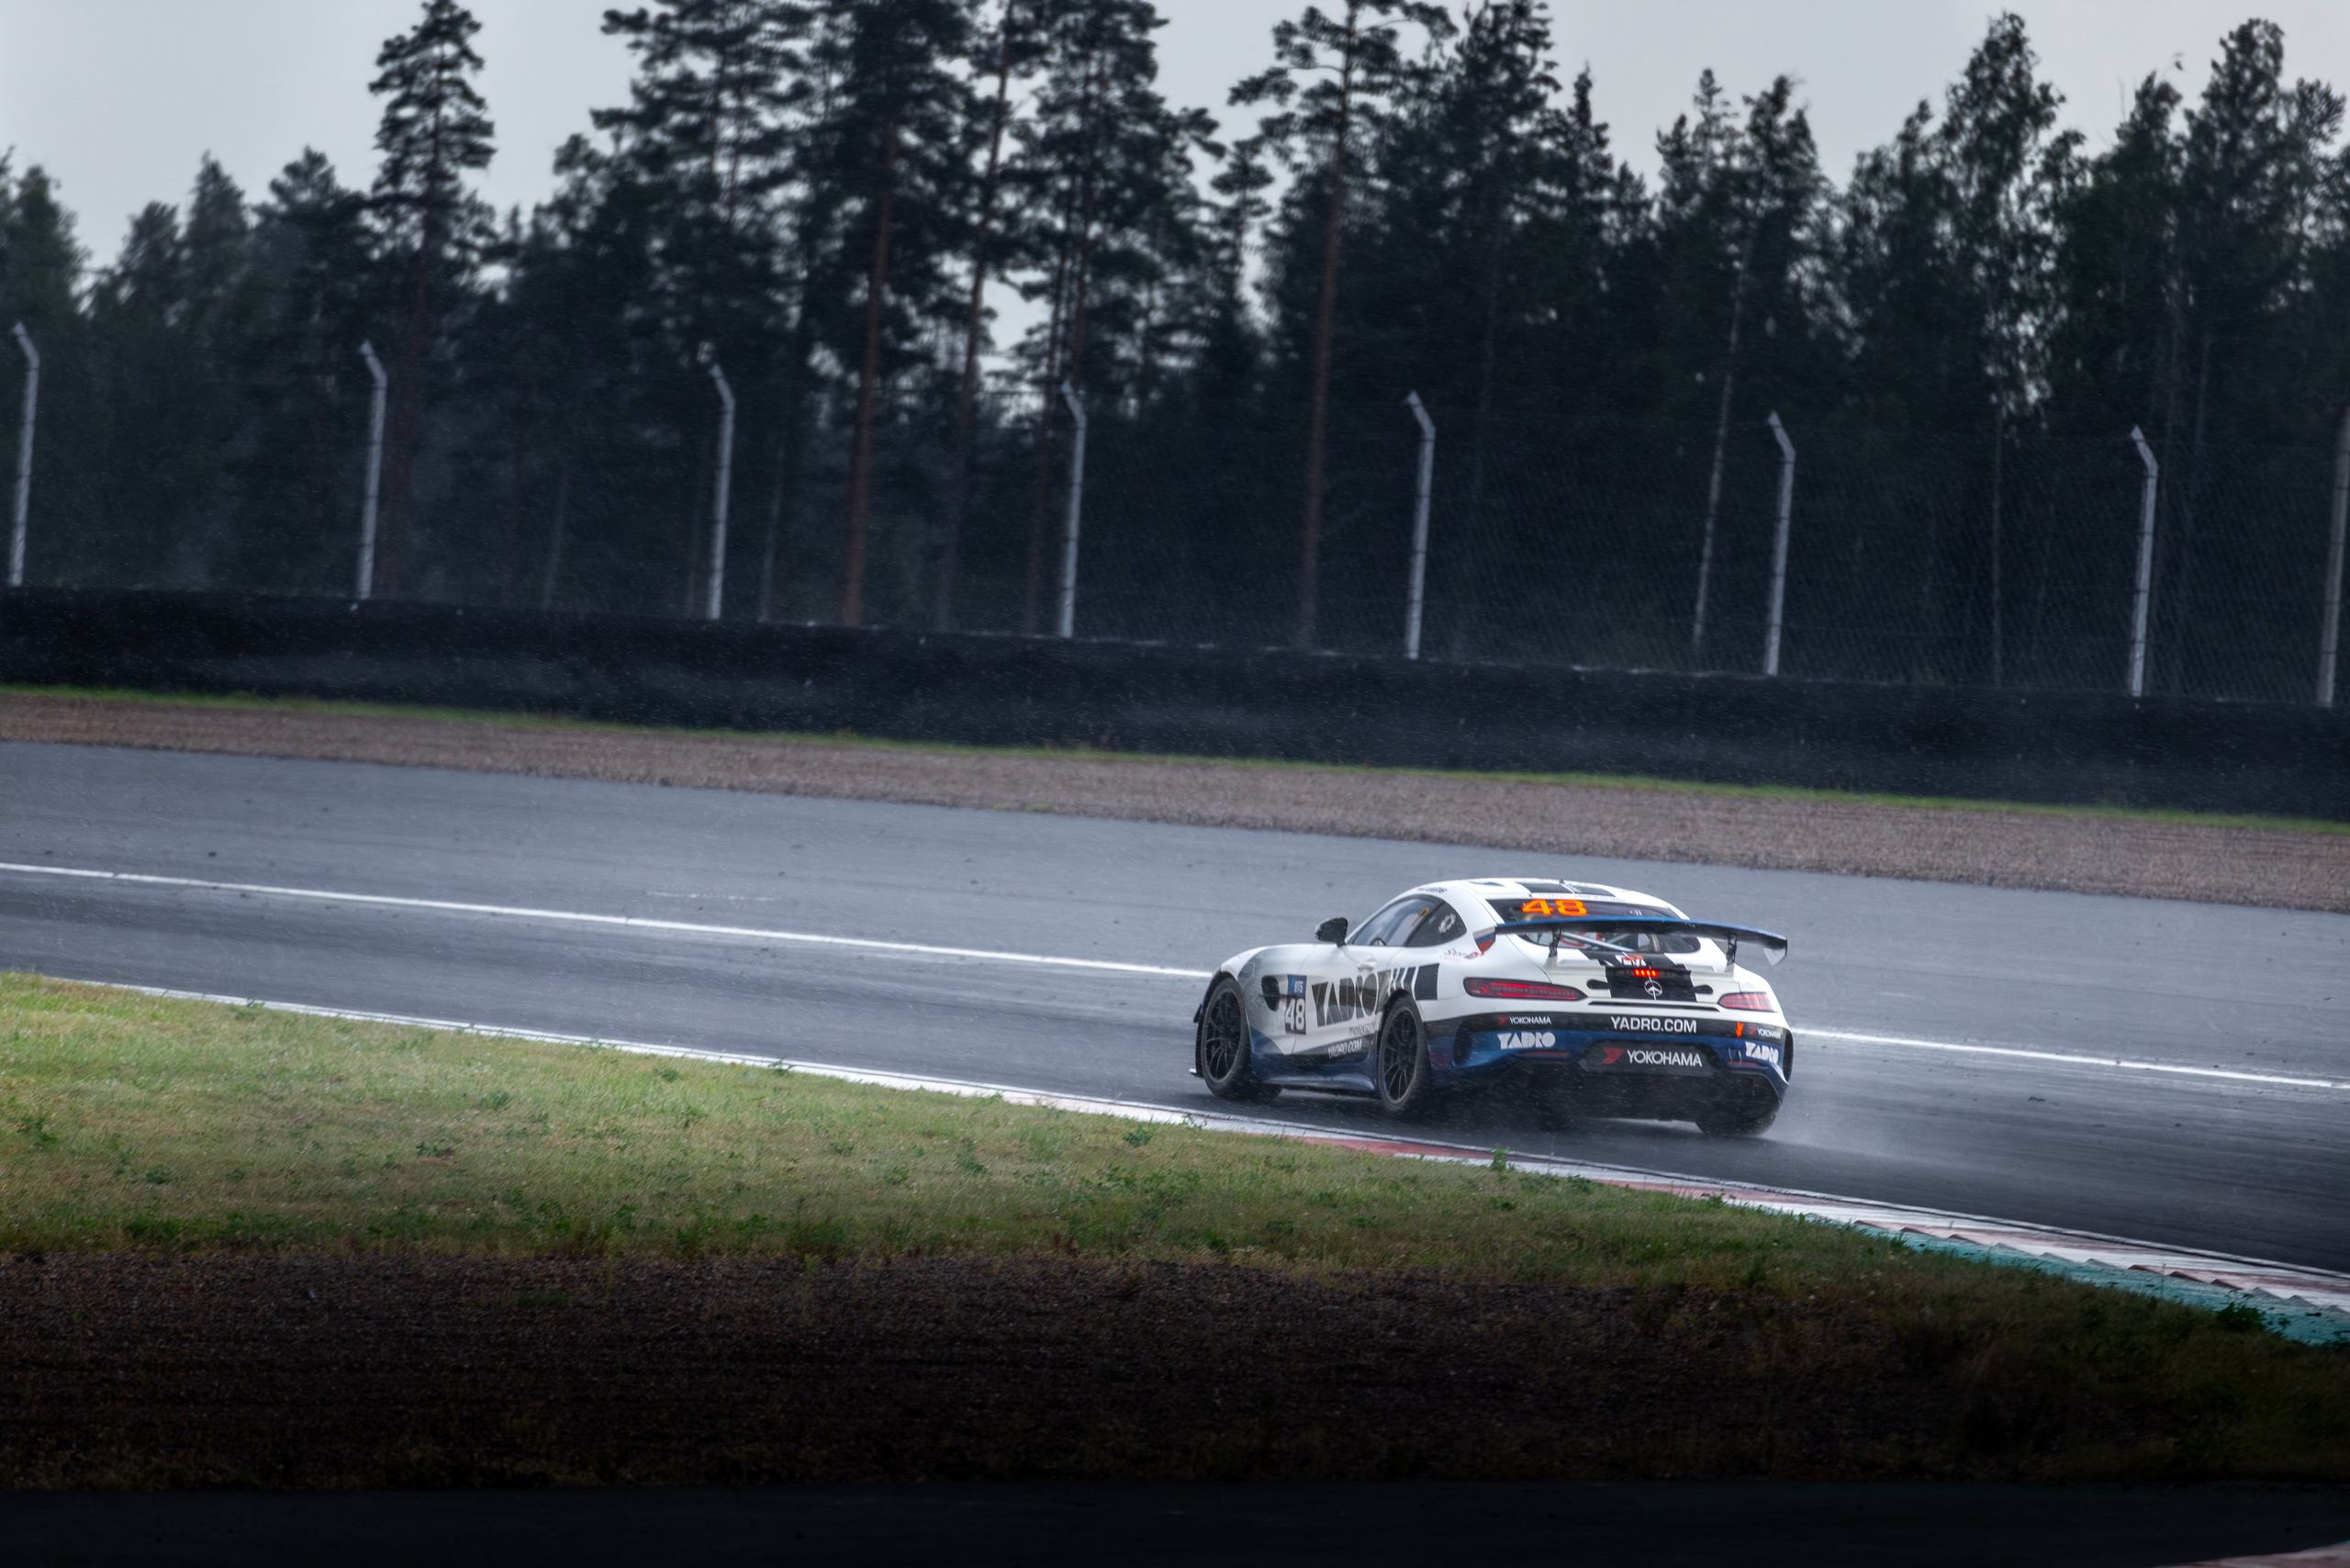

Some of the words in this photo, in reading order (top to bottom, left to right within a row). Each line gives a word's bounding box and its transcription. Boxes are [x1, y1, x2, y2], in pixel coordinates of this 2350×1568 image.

[1521, 898, 1588, 917] 48
[1311, 973, 1377, 1027] YADRO
[1285, 997, 1305, 1031] 48
[1508, 1015, 1552, 1025] YOKOHAMA
[1610, 1016, 1697, 1034] YADRO.COM
[1497, 1031, 1556, 1050] YADRO
[1627, 1049, 1703, 1068] YOKOHAMA
[1745, 1040, 1779, 1065] YADRO
